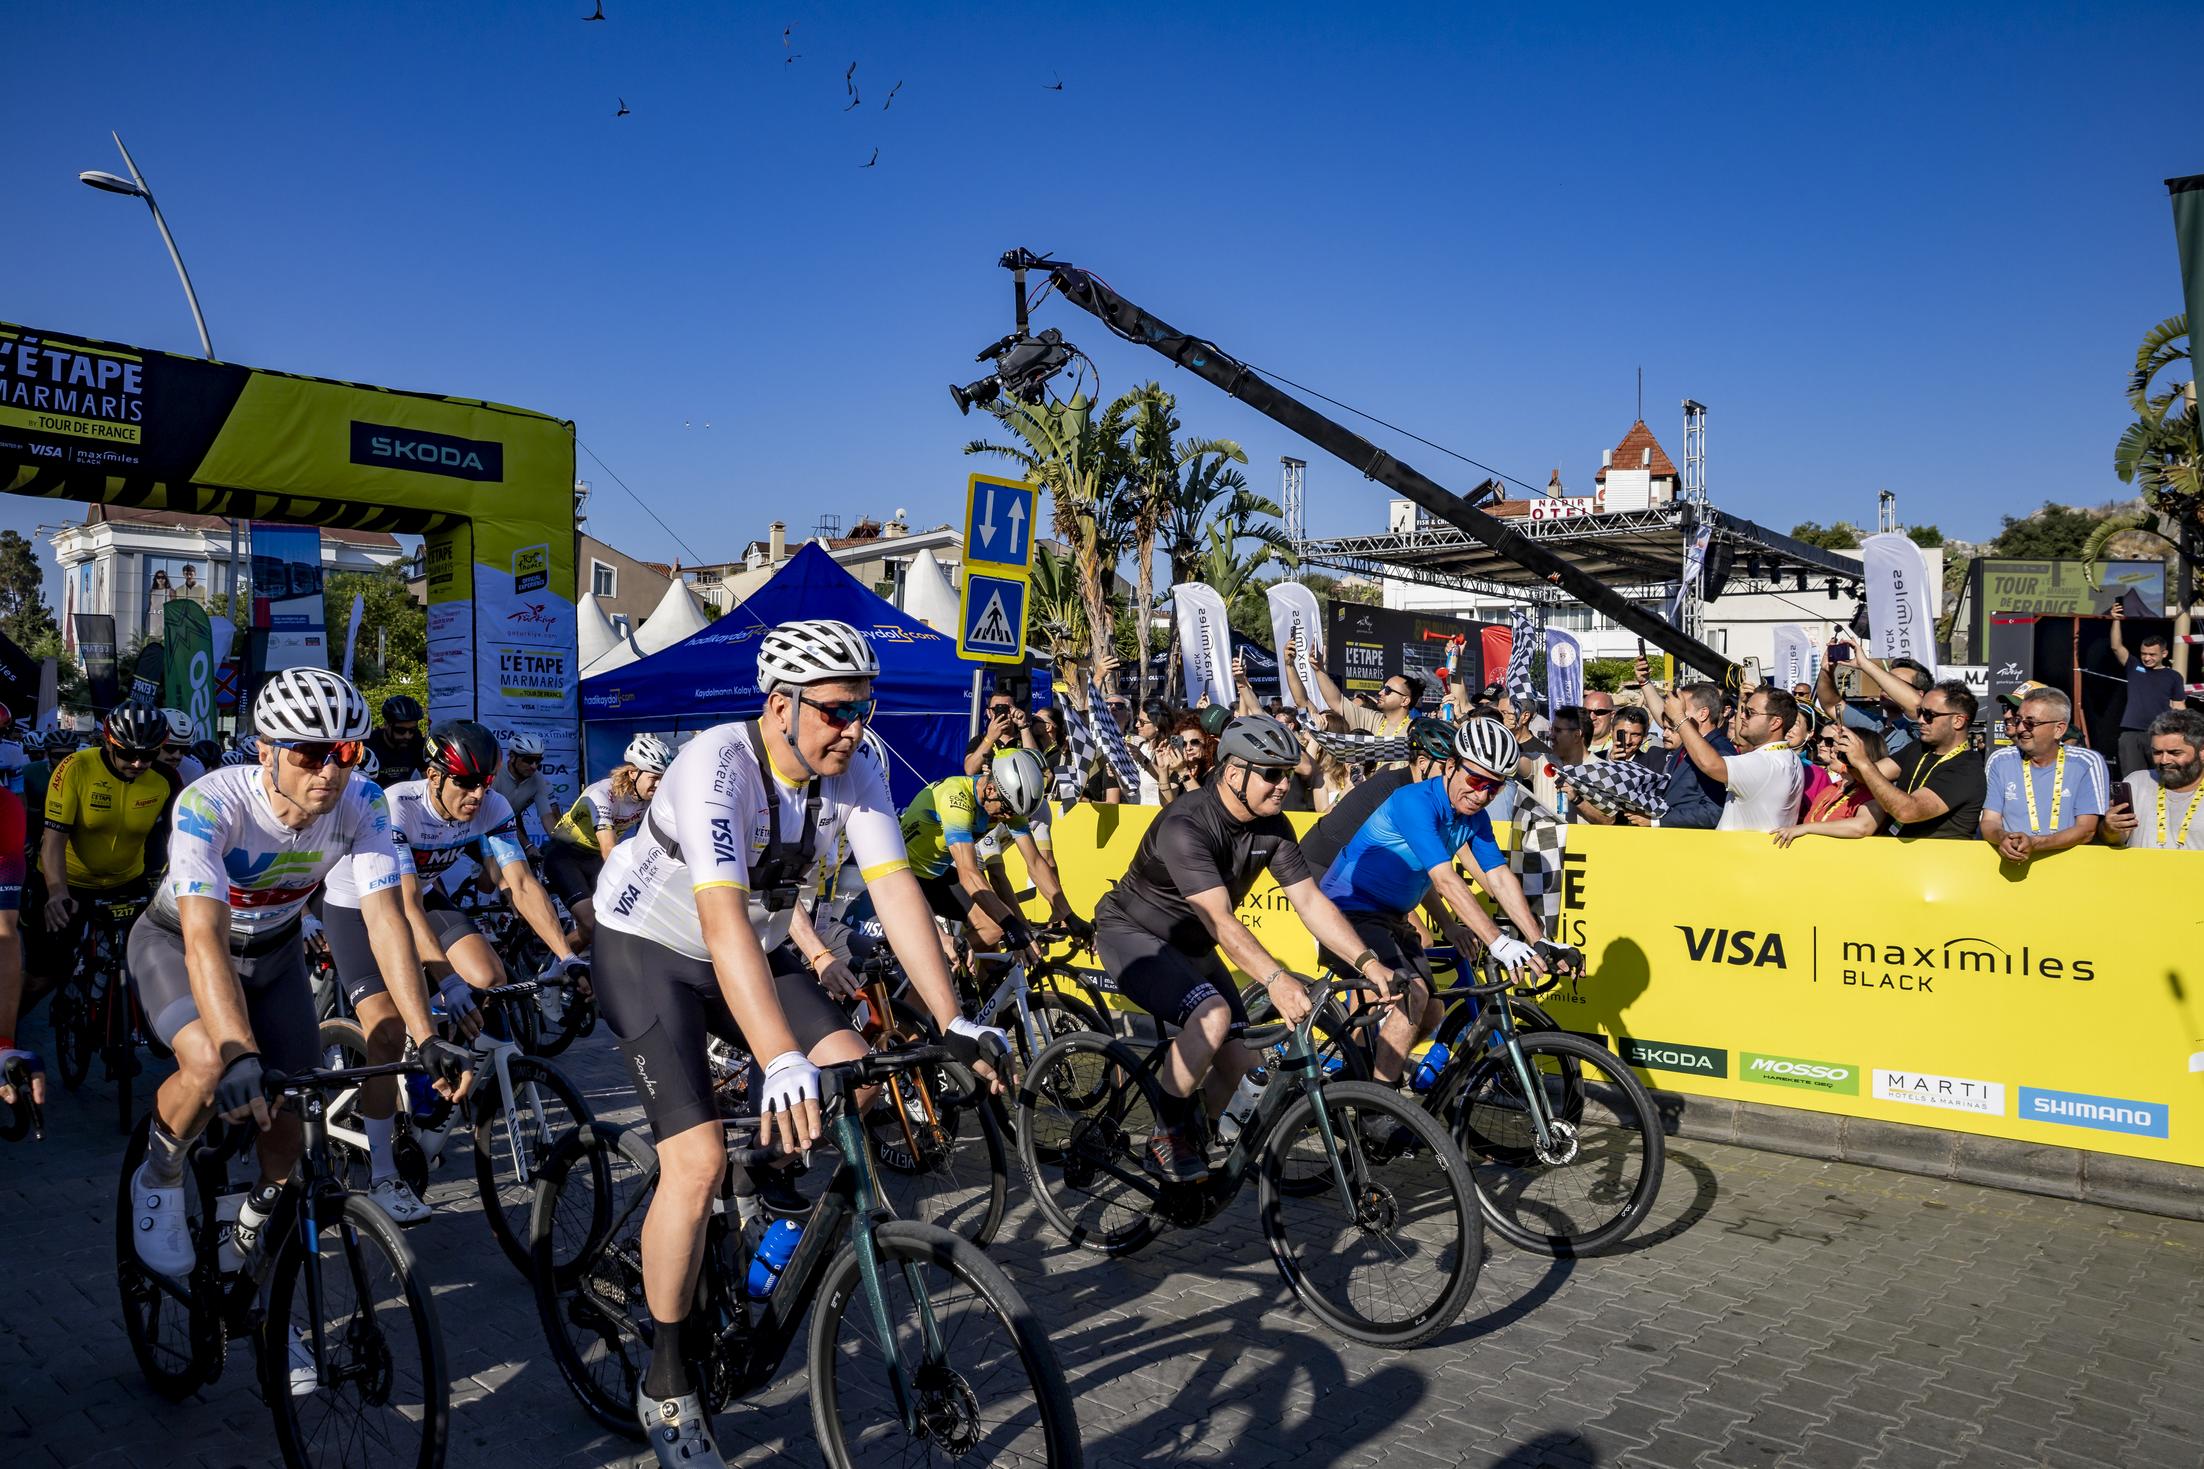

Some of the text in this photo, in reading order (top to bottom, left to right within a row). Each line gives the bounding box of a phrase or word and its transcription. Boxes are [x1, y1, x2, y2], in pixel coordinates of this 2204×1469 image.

[38, 416, 71, 432] TOUR
[73, 423, 89, 434] DE
[91, 424, 136, 440] FRANCE
[29, 443, 139, 464] VISA maximiles
[1995, 576, 2038, 596] TOUR
[2001, 597, 2012, 608] DE
[500, 650, 564, 675] L'ÉTAPE
[733, 685, 752, 697] Kolay
[521, 703, 535, 711] VISA
[726, 770, 738, 798] BLACK
[711, 818, 737, 867] VISA
[112, 907, 135, 919] 1217
[1673, 925, 2096, 981] VISA maximiles
[1844, 970, 1934, 993] BLACK
[1750, 1058, 1849, 1081] MOSSO
[1763, 1074, 1812, 1085] HAREKETE
[1888, 1073, 1988, 1099] MARTI
[1888, 1091, 1927, 1102] HOTELS
[1939, 1098, 1988, 1111] MARINAS
[2034, 1097, 2152, 1127] SHIMANO
